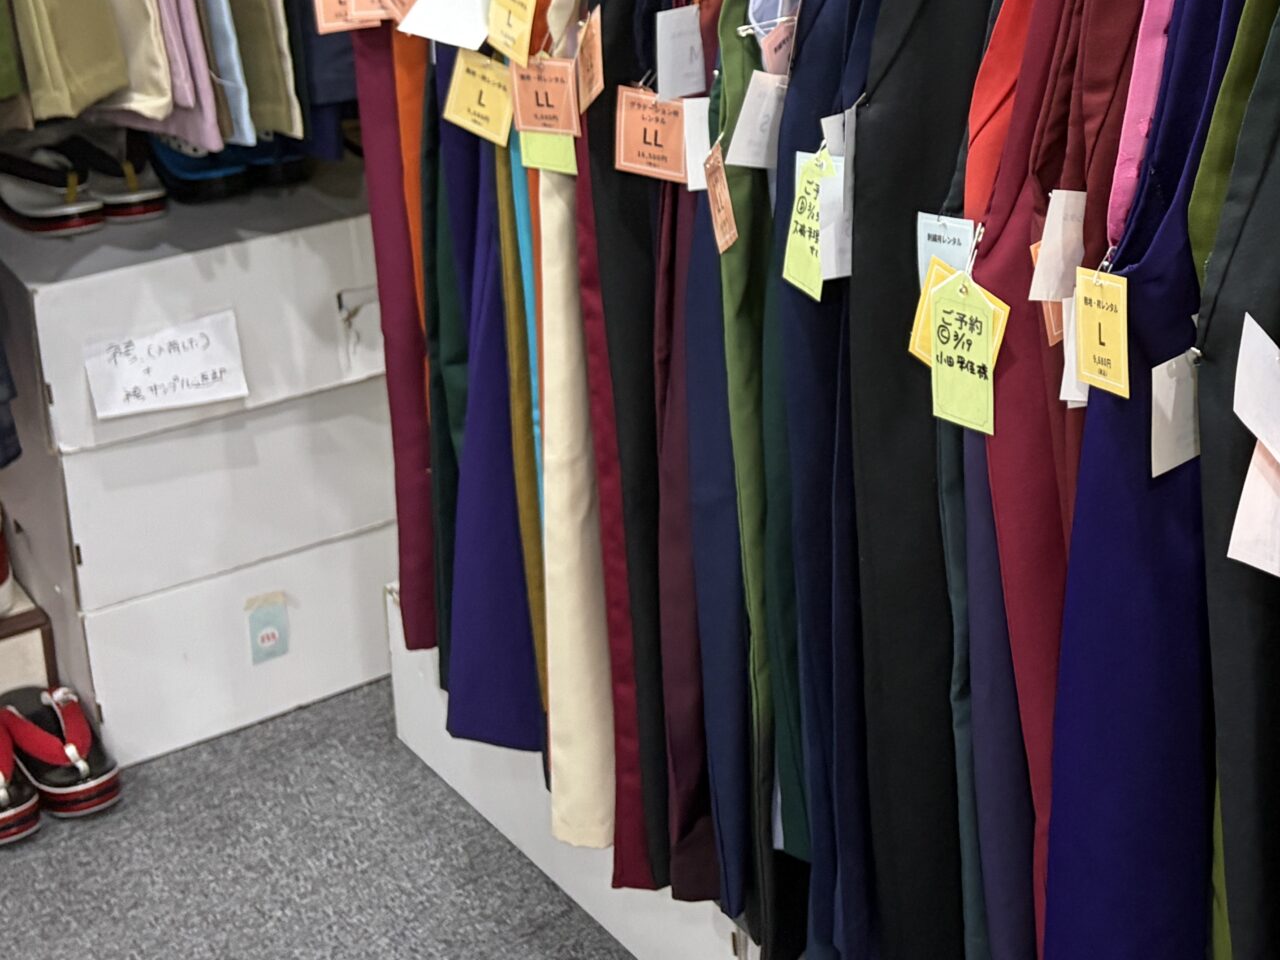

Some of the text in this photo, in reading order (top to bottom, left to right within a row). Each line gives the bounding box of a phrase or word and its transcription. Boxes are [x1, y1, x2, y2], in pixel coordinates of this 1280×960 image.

[477, 89, 486, 108] L
[535, 90, 554, 108] LL
[643, 127, 663, 148] LL
[941, 309, 983, 336] ご予約
[1098, 322, 1106, 347] L
